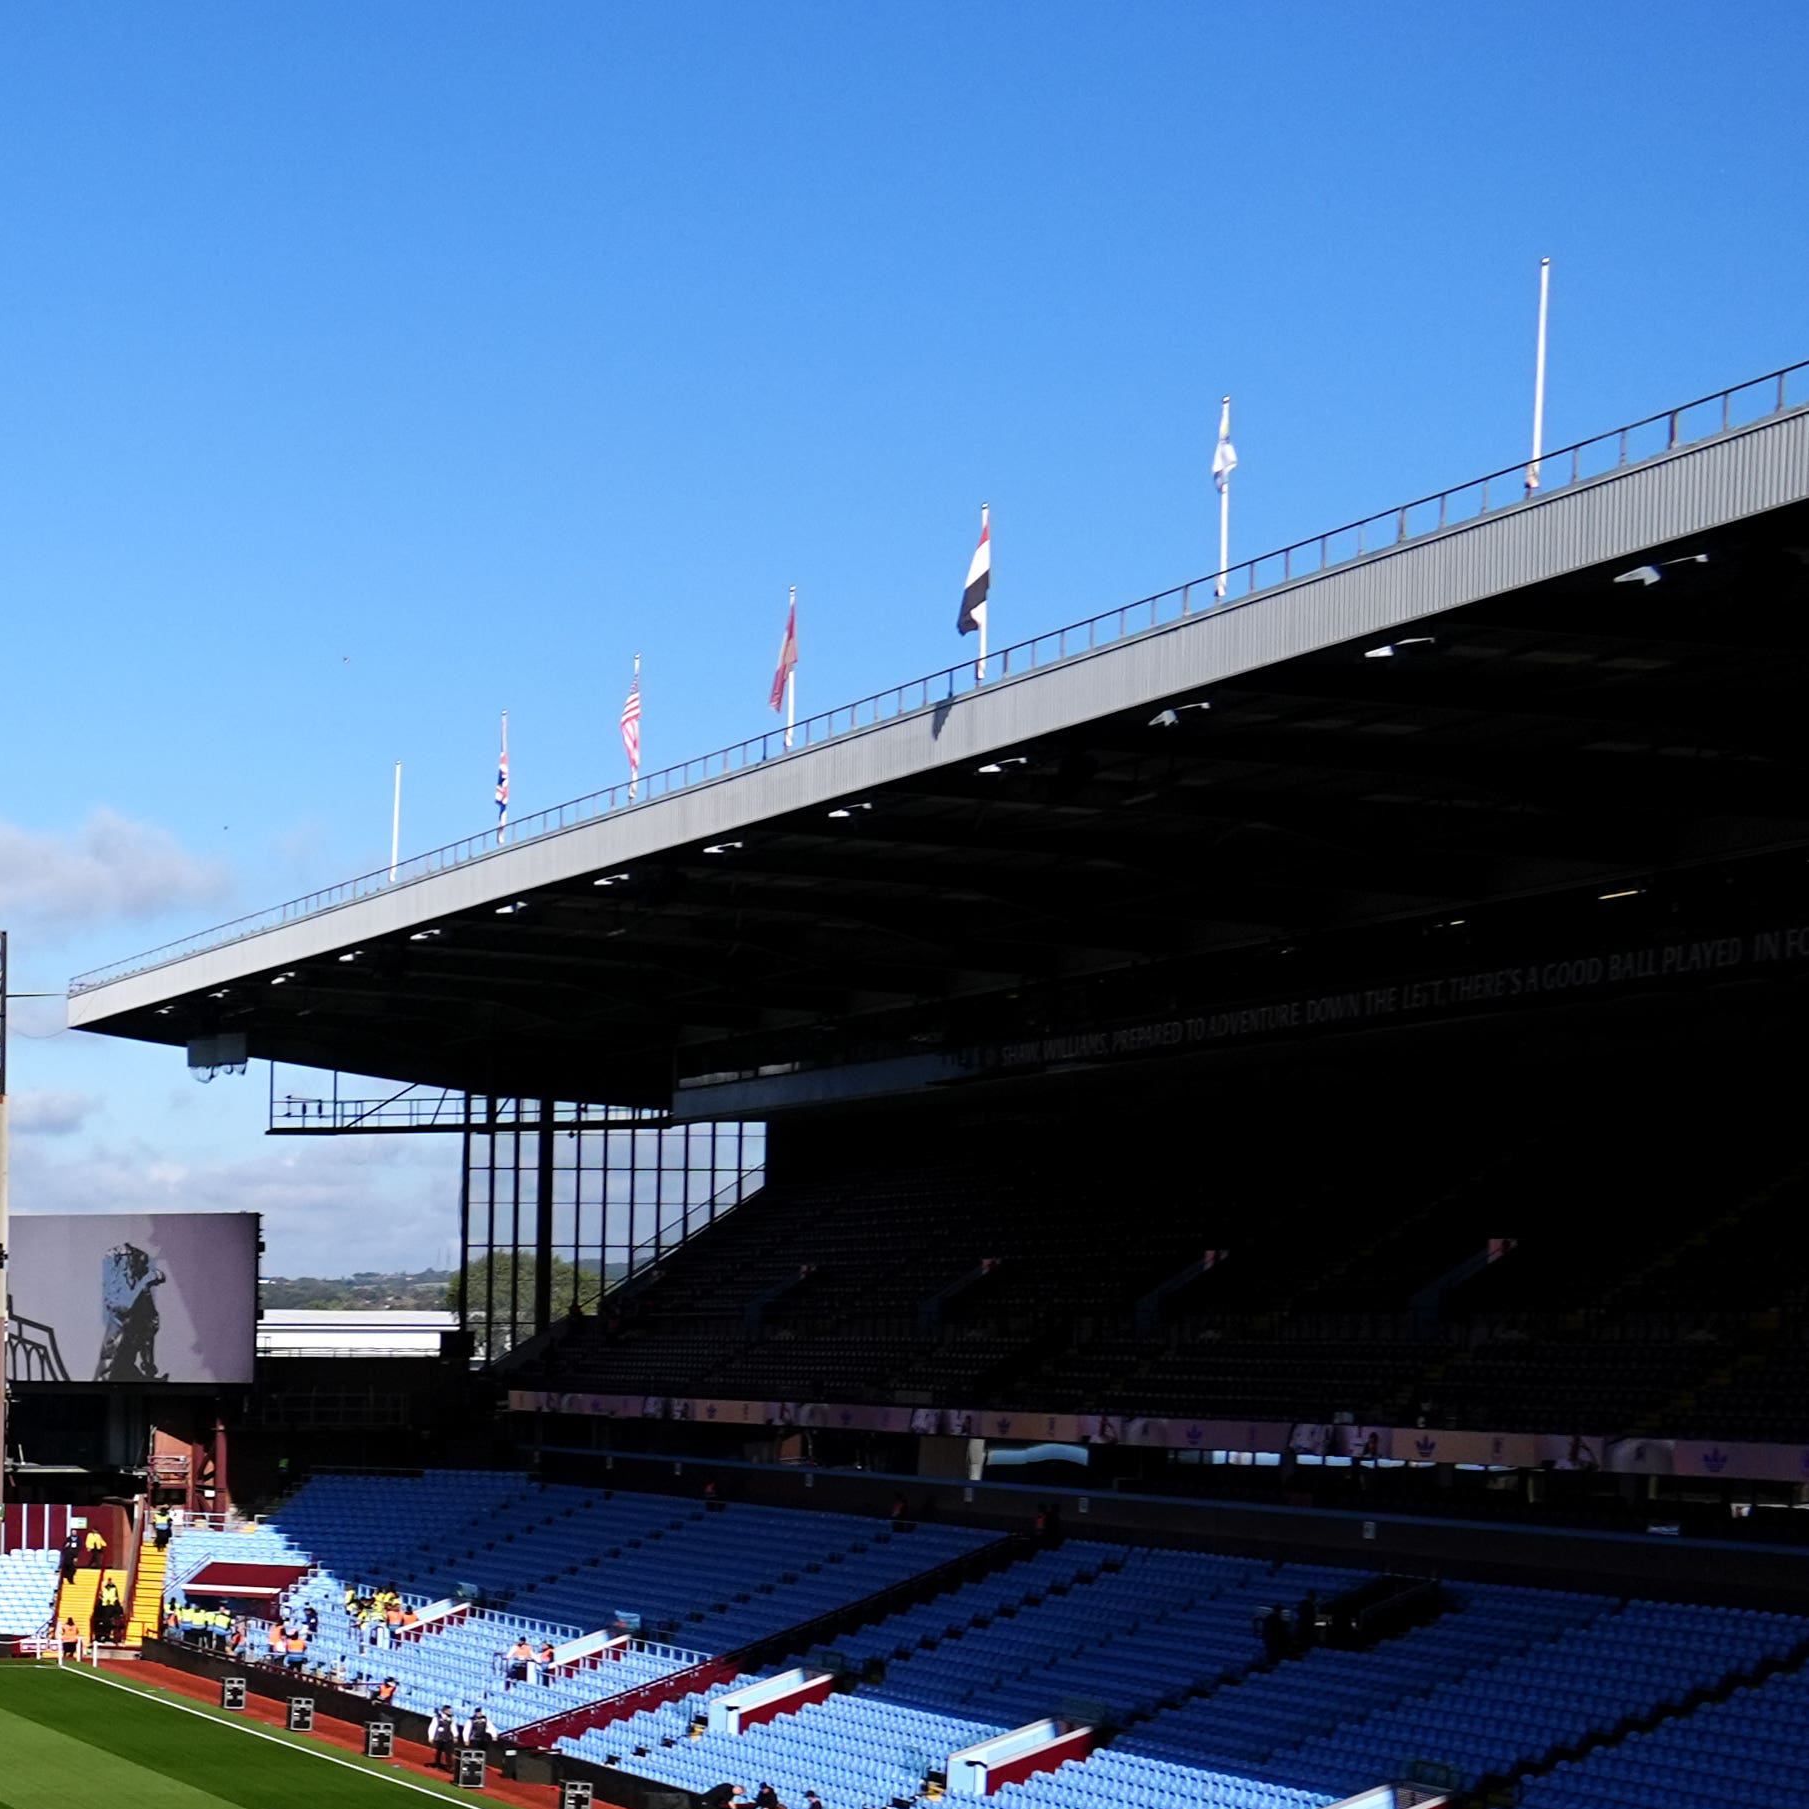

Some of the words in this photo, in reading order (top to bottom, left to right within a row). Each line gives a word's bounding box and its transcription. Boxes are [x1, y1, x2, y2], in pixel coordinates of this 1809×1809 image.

[1111, 1021, 1182, 1053] PREPARED
[1184, 1017, 1205, 1041] TO
[1207, 1002, 1301, 1038] ADVENTURE
[1305, 991, 1361, 1025] DOWN
[1363, 986, 1398, 1016] THE
[1447, 966, 1523, 1003] THERE'S
[1523, 965, 1539, 993] A
[1541, 956, 1603, 991] GOOD
[1608, 944, 1658, 981] BALL
[1661, 936, 1743, 975] PLAYED
[1752, 930, 1781, 963] IN
